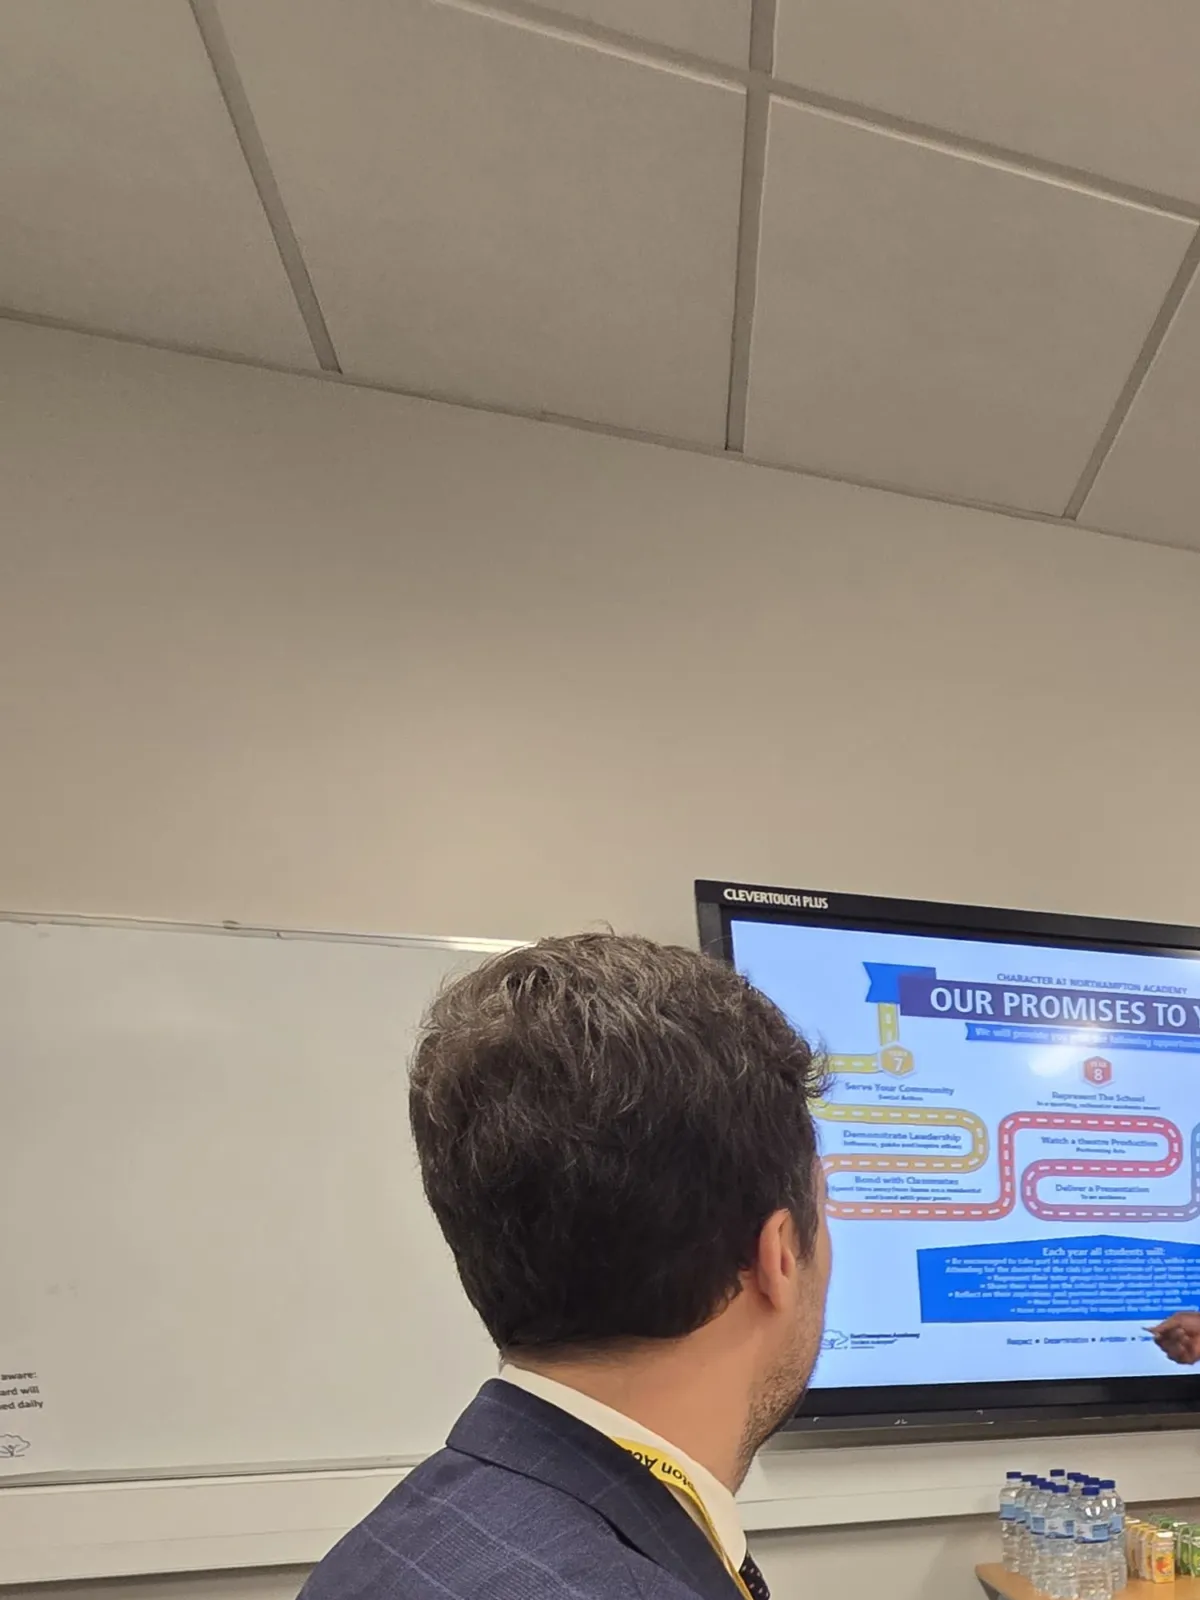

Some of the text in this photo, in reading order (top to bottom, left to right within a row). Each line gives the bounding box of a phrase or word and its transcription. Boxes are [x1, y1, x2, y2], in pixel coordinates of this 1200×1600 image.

[723, 888, 829, 909] CLEVERTOUCH PLUS
[997, 973, 1053, 985] CHARACTER
[1070, 978, 1140, 991] NORTHAMPTON
[1143, 984, 1187, 995] ACADEMY
[930, 987, 994, 1015] OUR
[1003, 991, 1146, 1025] PROMISES
[1152, 1002, 1187, 1027] TO
[893, 1057, 903, 1072] 7
[1093, 1068, 1103, 1081] 8
[845, 1082, 955, 1096] Serve Your Community
[1052, 1091, 1145, 1102] Represent The School
[843, 1130, 961, 1143] Demonstrate Leadership
[1041, 1137, 1069, 1145] Watch
[1111, 1139, 1158, 1147] Production
[855, 1176, 880, 1184] Bond
[883, 1176, 904, 1184] with
[1055, 1184, 1086, 1192] Deliver
[1096, 1185, 1150, 1193] Presentation
[1042, 1247, 1066, 1256] Each
[1068, 1248, 1088, 1257] year
[1104, 1247, 1144, 1256] students
[1, 1372, 37, 1381] aware:
[20, 1386, 40, 1394] will
[18, 1400, 43, 1409] daily
